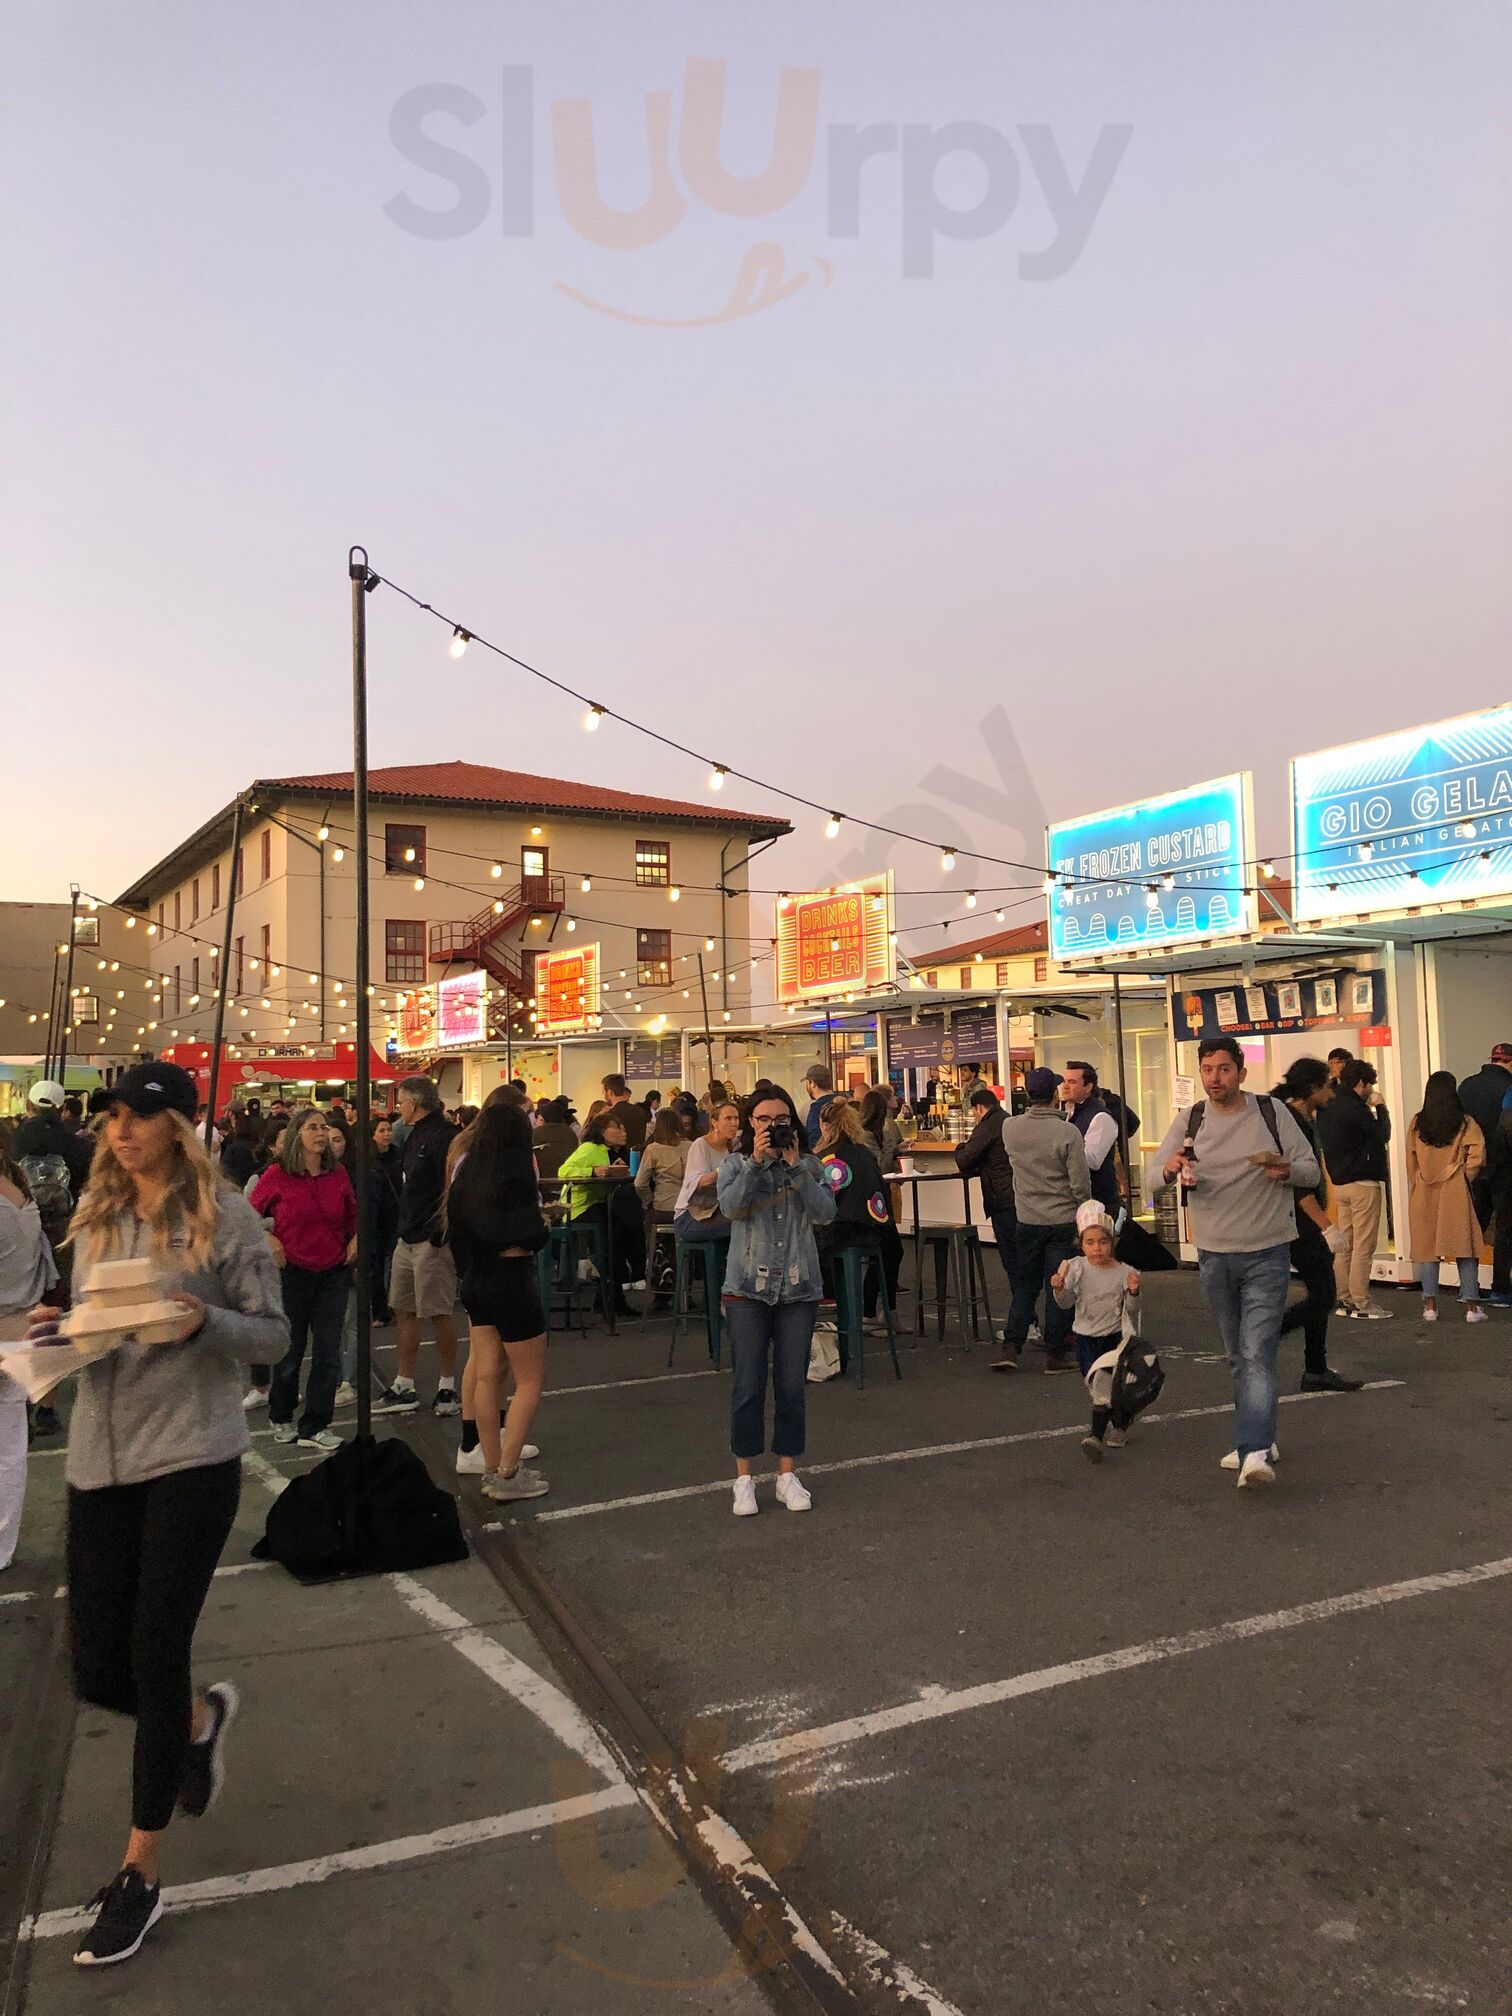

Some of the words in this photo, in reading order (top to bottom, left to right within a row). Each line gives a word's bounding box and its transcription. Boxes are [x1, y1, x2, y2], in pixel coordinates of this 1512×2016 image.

[1320, 796, 1392, 838] GIO
[1079, 841, 1142, 881] FROZEN
[1147, 820, 1231, 866] CUSTARD
[1107, 884, 1131, 899] DAY
[1186, 865, 1232, 882] STICK
[801, 898, 858, 933] DRINKS
[803, 950, 861, 982] BEER
